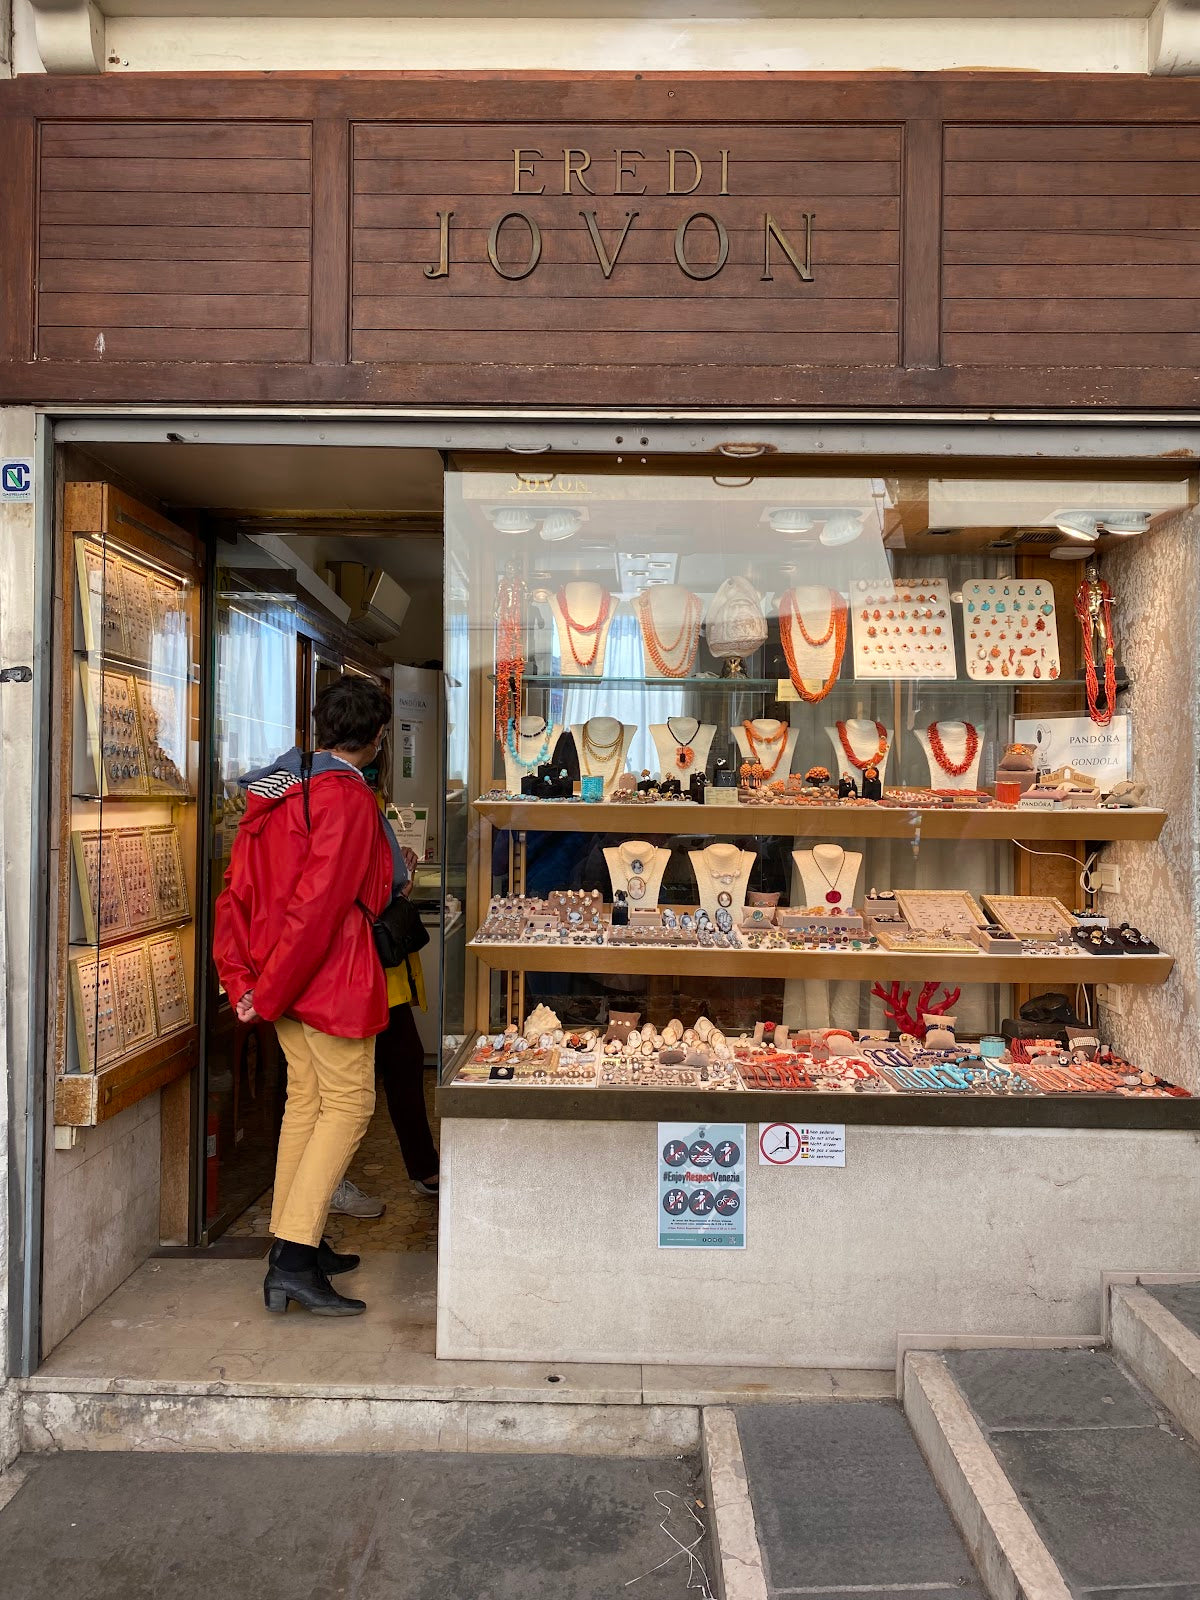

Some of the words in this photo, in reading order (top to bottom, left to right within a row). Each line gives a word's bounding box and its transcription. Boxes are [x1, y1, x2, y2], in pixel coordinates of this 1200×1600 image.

[512, 149, 731, 196] EREDI
[423, 211, 815, 282] JOVON
[1071, 758, 1119, 766] GONDOLA
[663, 1171, 740, 1184] #EnjoyRespectVenezia
